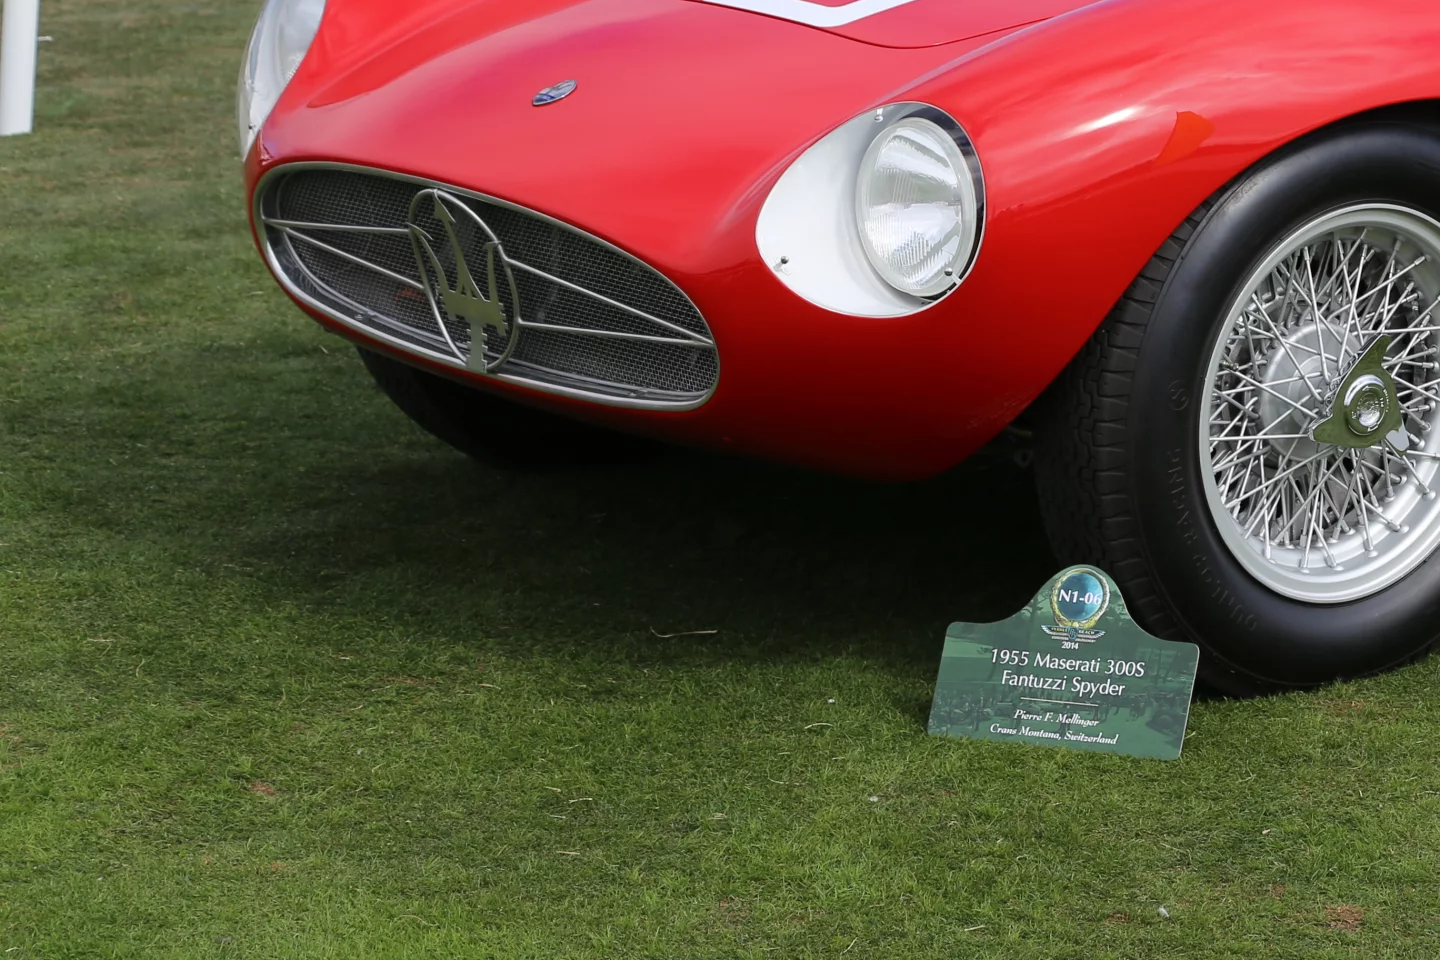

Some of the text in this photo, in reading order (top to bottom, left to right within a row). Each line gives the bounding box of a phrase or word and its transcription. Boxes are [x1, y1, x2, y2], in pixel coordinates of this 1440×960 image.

[1058, 589, 1102, 605] N1-06
[1061, 641, 1079, 649] 2014
[991, 648, 1145, 677] 1955 Maserati 300S
[1001, 670, 1125, 698] Fantuzzi Spyder
[1013, 709, 1099, 727] Pierre F. Mellinger
[990, 723, 1119, 744] Crans Montana, Switzerland
